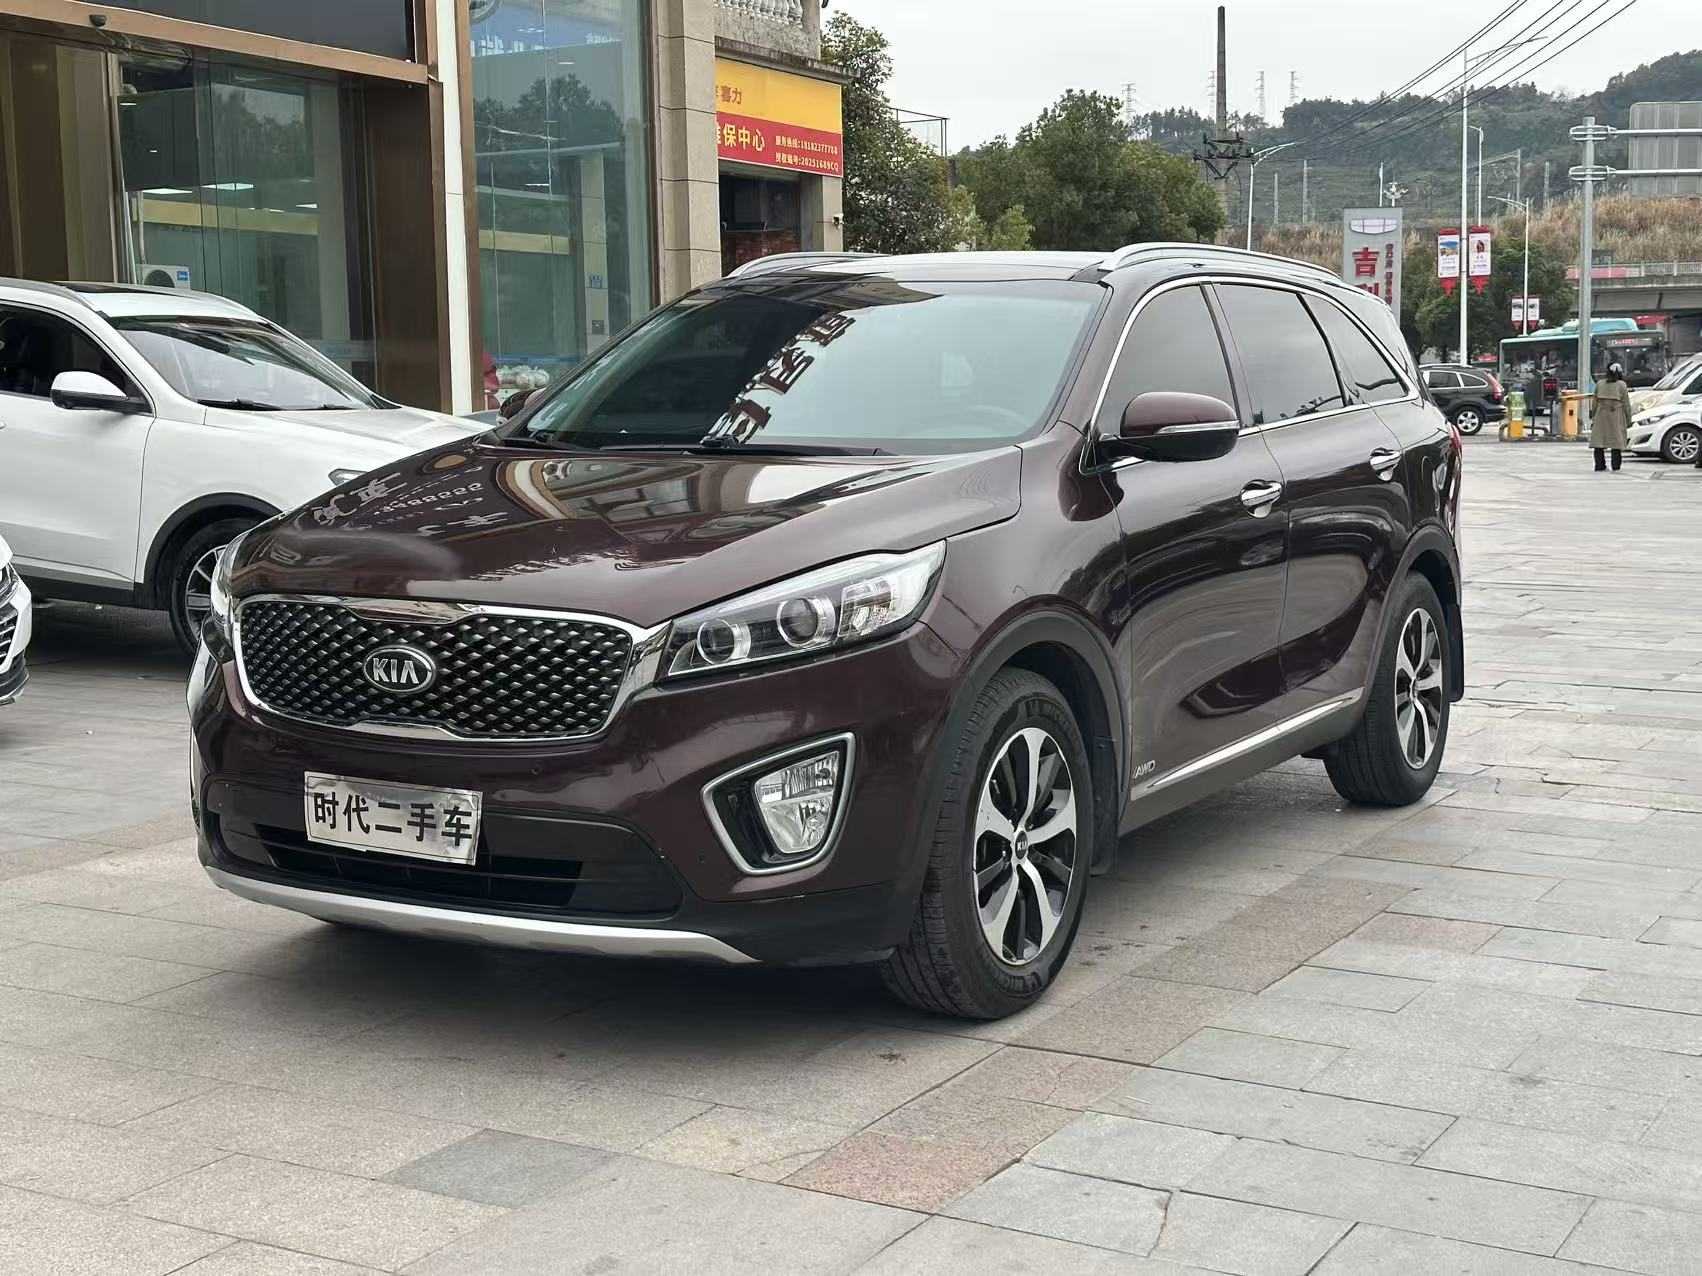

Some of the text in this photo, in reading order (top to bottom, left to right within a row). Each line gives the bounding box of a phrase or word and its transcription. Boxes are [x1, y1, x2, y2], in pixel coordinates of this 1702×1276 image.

[715, 85, 742, 105] 喜力
[372, 657, 420, 684] KIA
[1134, 760, 1156, 779] AWD
[313, 791, 473, 847] 时代二手车
